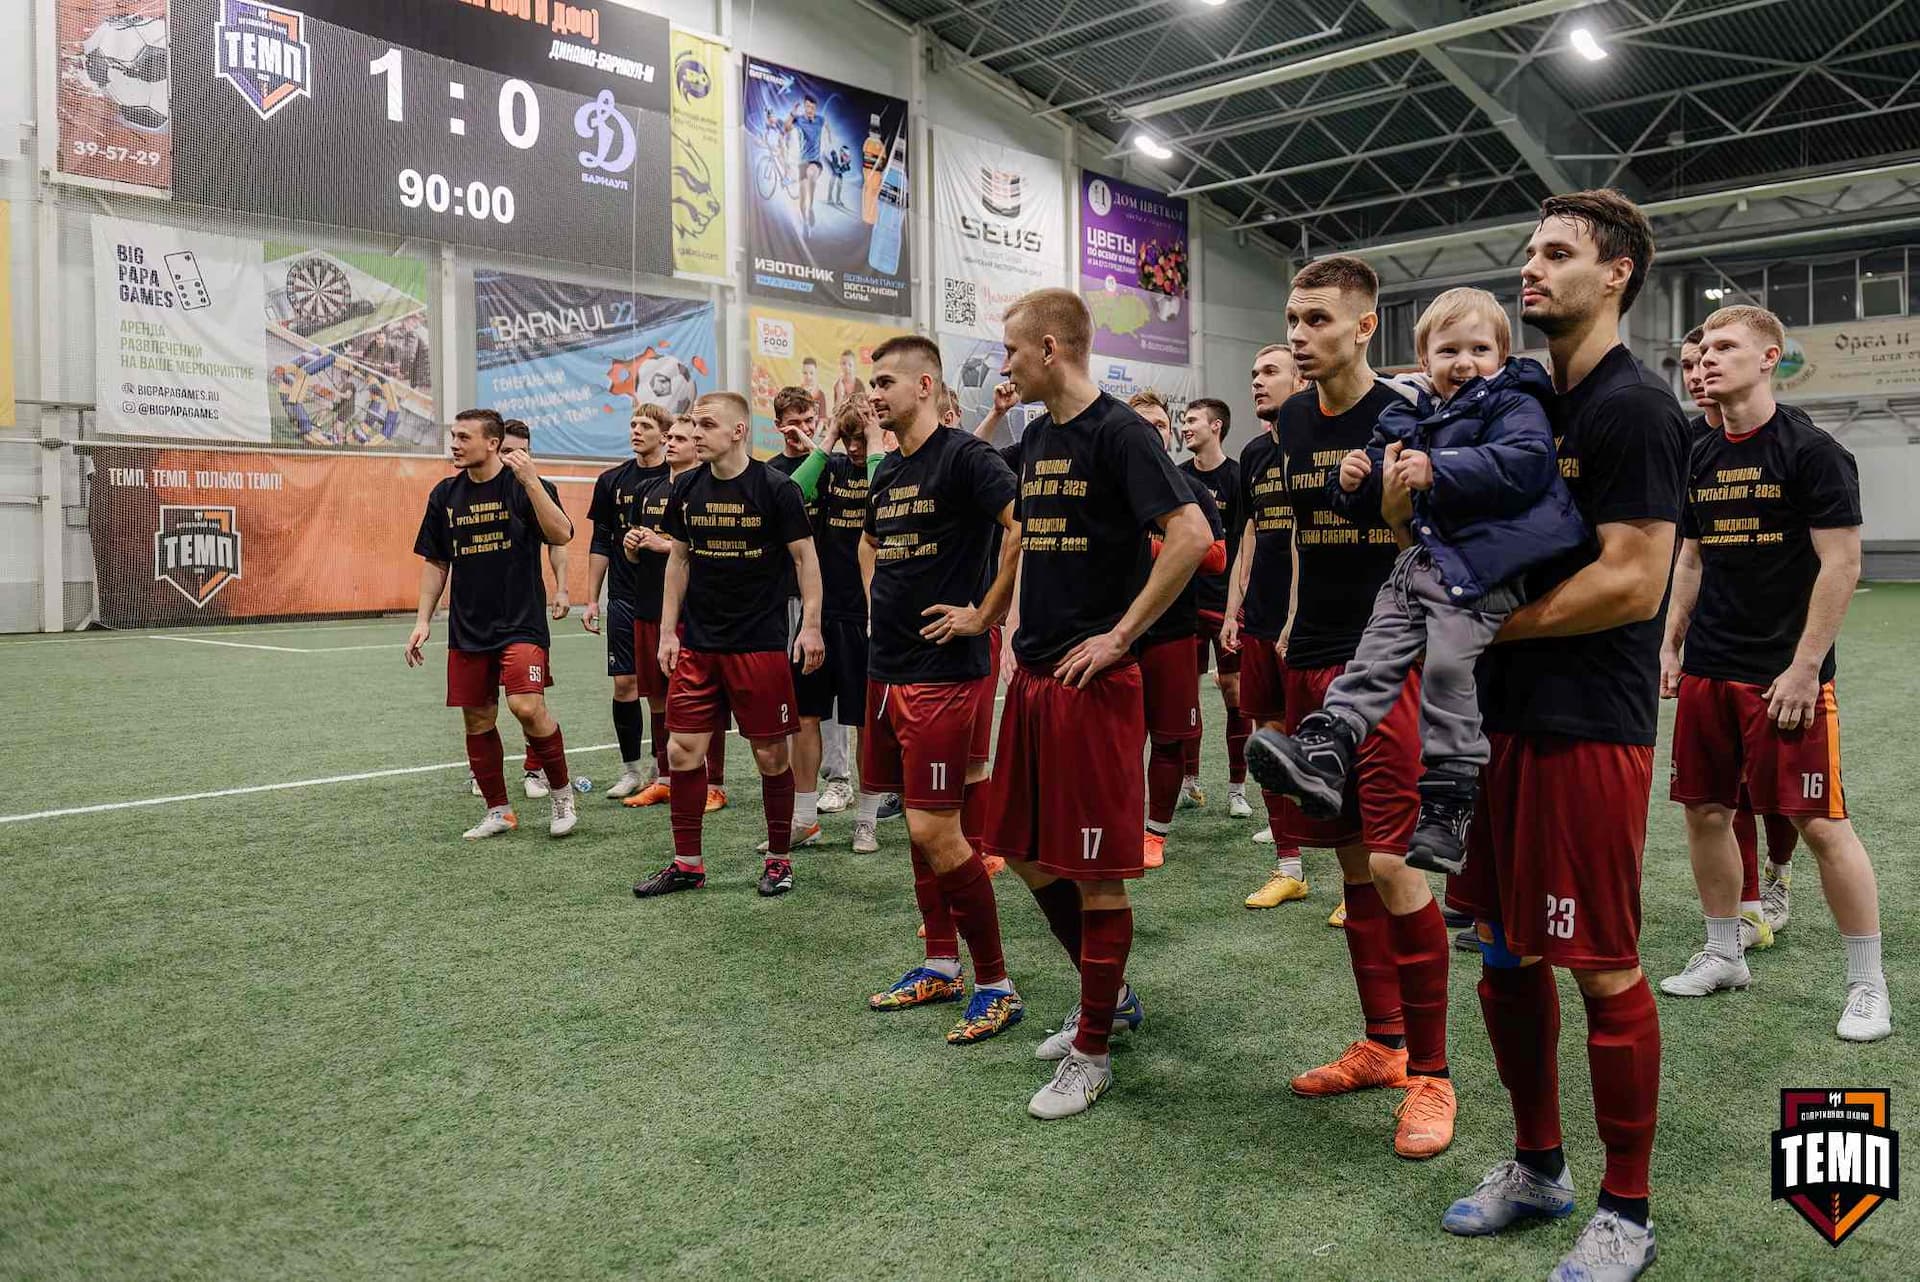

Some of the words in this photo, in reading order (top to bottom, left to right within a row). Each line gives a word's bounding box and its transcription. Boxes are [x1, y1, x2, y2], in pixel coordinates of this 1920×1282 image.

[224, 31, 302, 83] ТЕМП
[369, 48, 404, 122] 1
[499, 79, 540, 150] 0
[73, 140, 160, 166] 39-57-29
[398, 168, 515, 224] 90:00
[961, 215, 1043, 253] SEUS
[1087, 226, 1136, 254] ЦВЕТЫ
[117, 244, 144, 265] BIG
[118, 264, 160, 287] PAPA
[755, 257, 834, 282] ИЗОТОНИК
[119, 284, 174, 308] GAMES
[120, 319, 166, 337] АРЕНДА
[121, 354, 136, 369] НА
[139, 356, 173, 373] ВАШЕ
[138, 402, 220, 420] @BIGPAPAGAMES
[108, 468, 148, 489] ТЕМП,
[152, 469, 191, 489] ТЕМП,
[196, 471, 243, 490] ТОЛЬКО
[247, 472, 282, 490] ТЕМП!
[1292, 469, 1325, 490] ТРЕТЬЕЙ
[1755, 484, 1781, 498] 2025
[1322, 529, 1359, 544] СИБИРИ
[164, 534, 233, 569] ТЕМП
[529, 665, 541, 682] 55
[781, 703, 789, 723] 2
[930, 763, 946, 791] 11
[1801, 772, 1823, 799] 16
[1081, 828, 1103, 860] 17
[1546, 894, 1576, 940] 23
